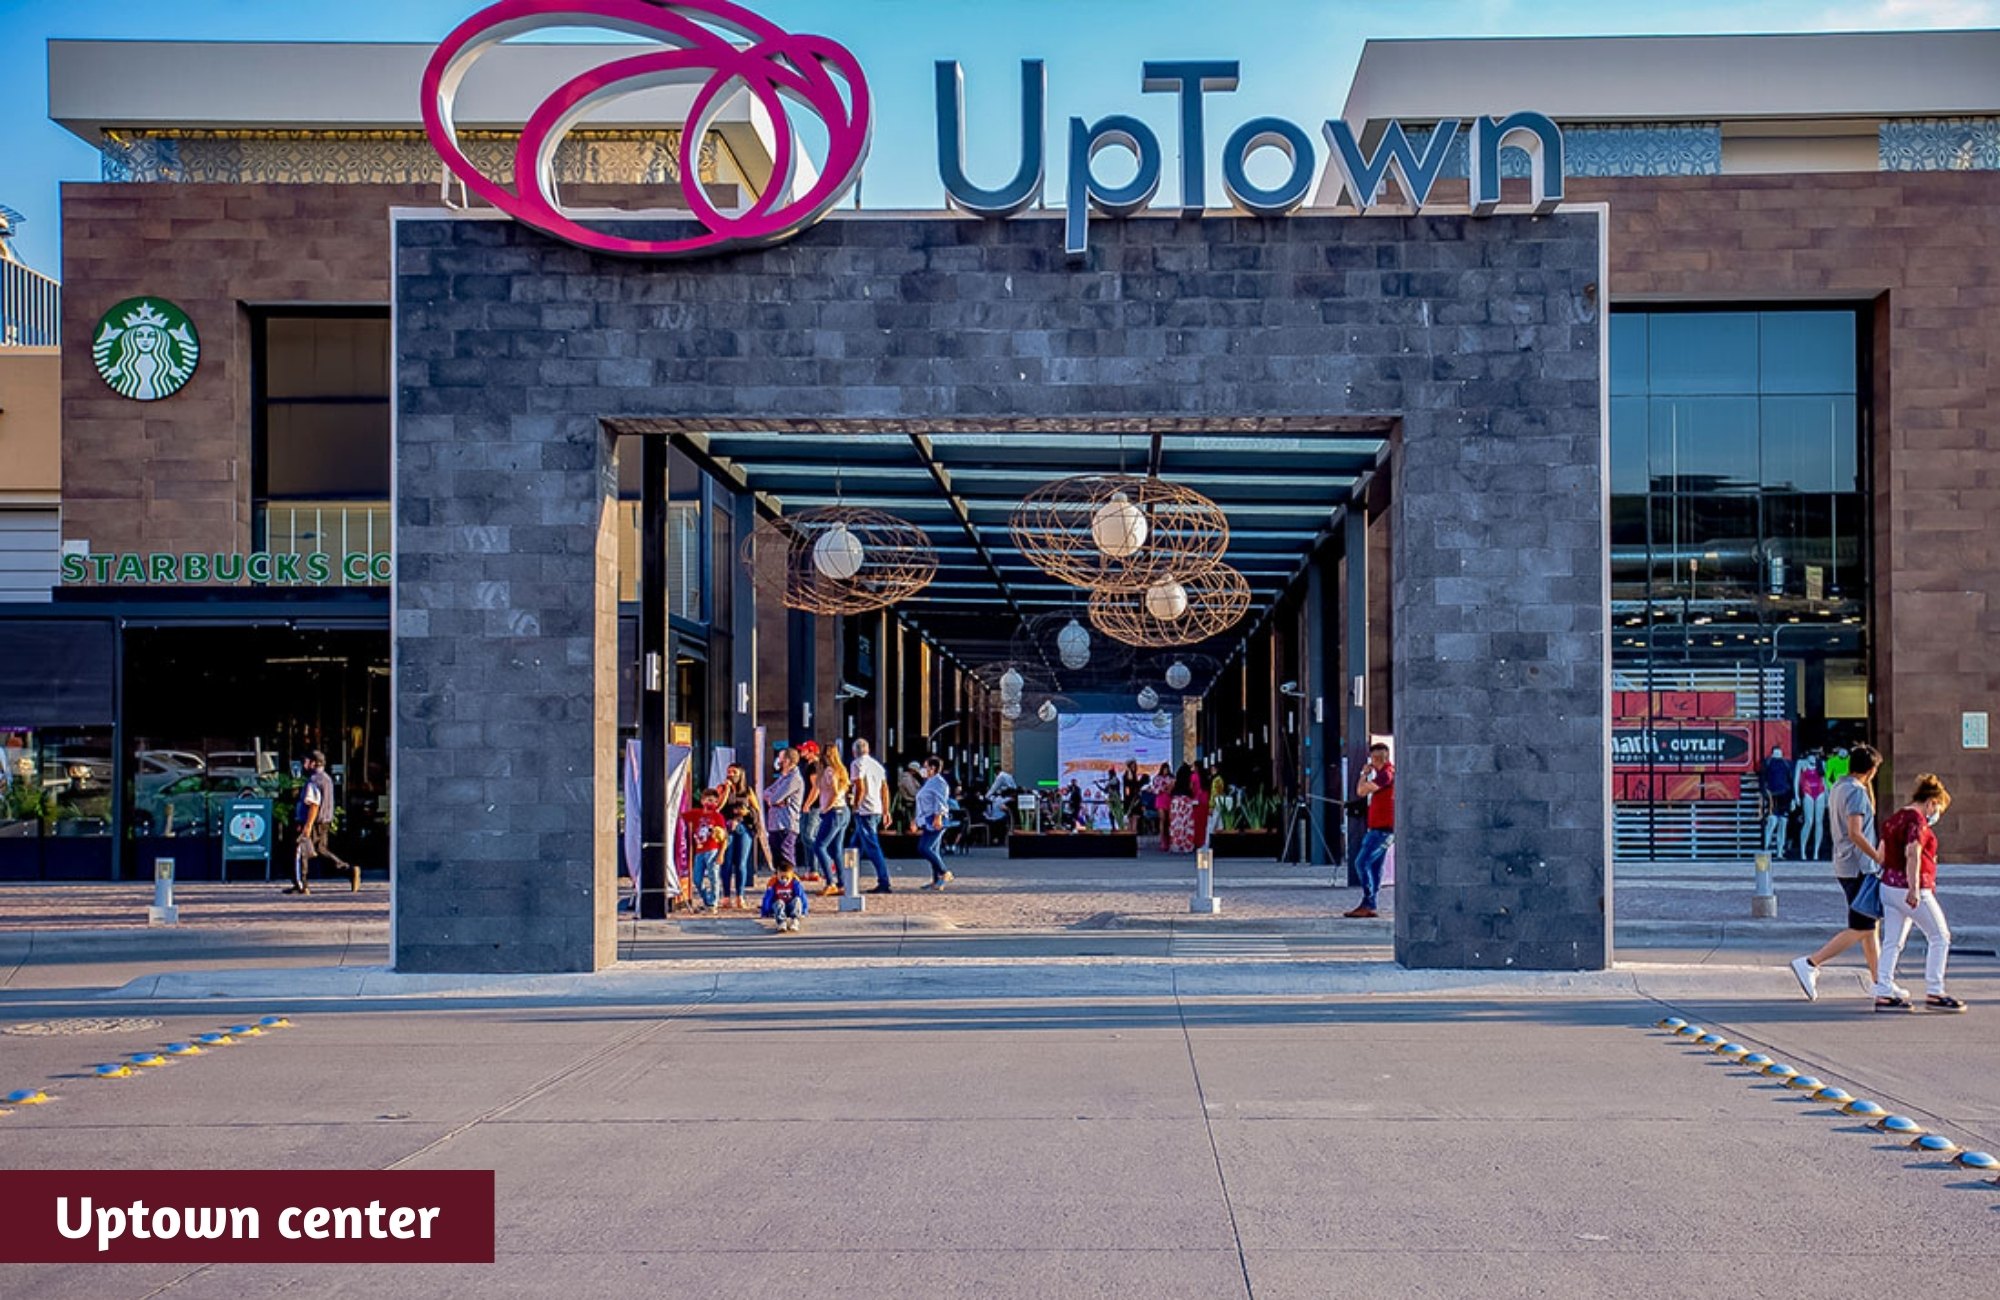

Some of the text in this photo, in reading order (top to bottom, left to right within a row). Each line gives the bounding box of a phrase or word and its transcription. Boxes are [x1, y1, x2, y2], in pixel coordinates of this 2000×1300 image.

[934, 58, 1565, 253] UpTown
[61, 552, 330, 583] STARBUCKS
[1670, 738, 1726, 751] OUTLET
